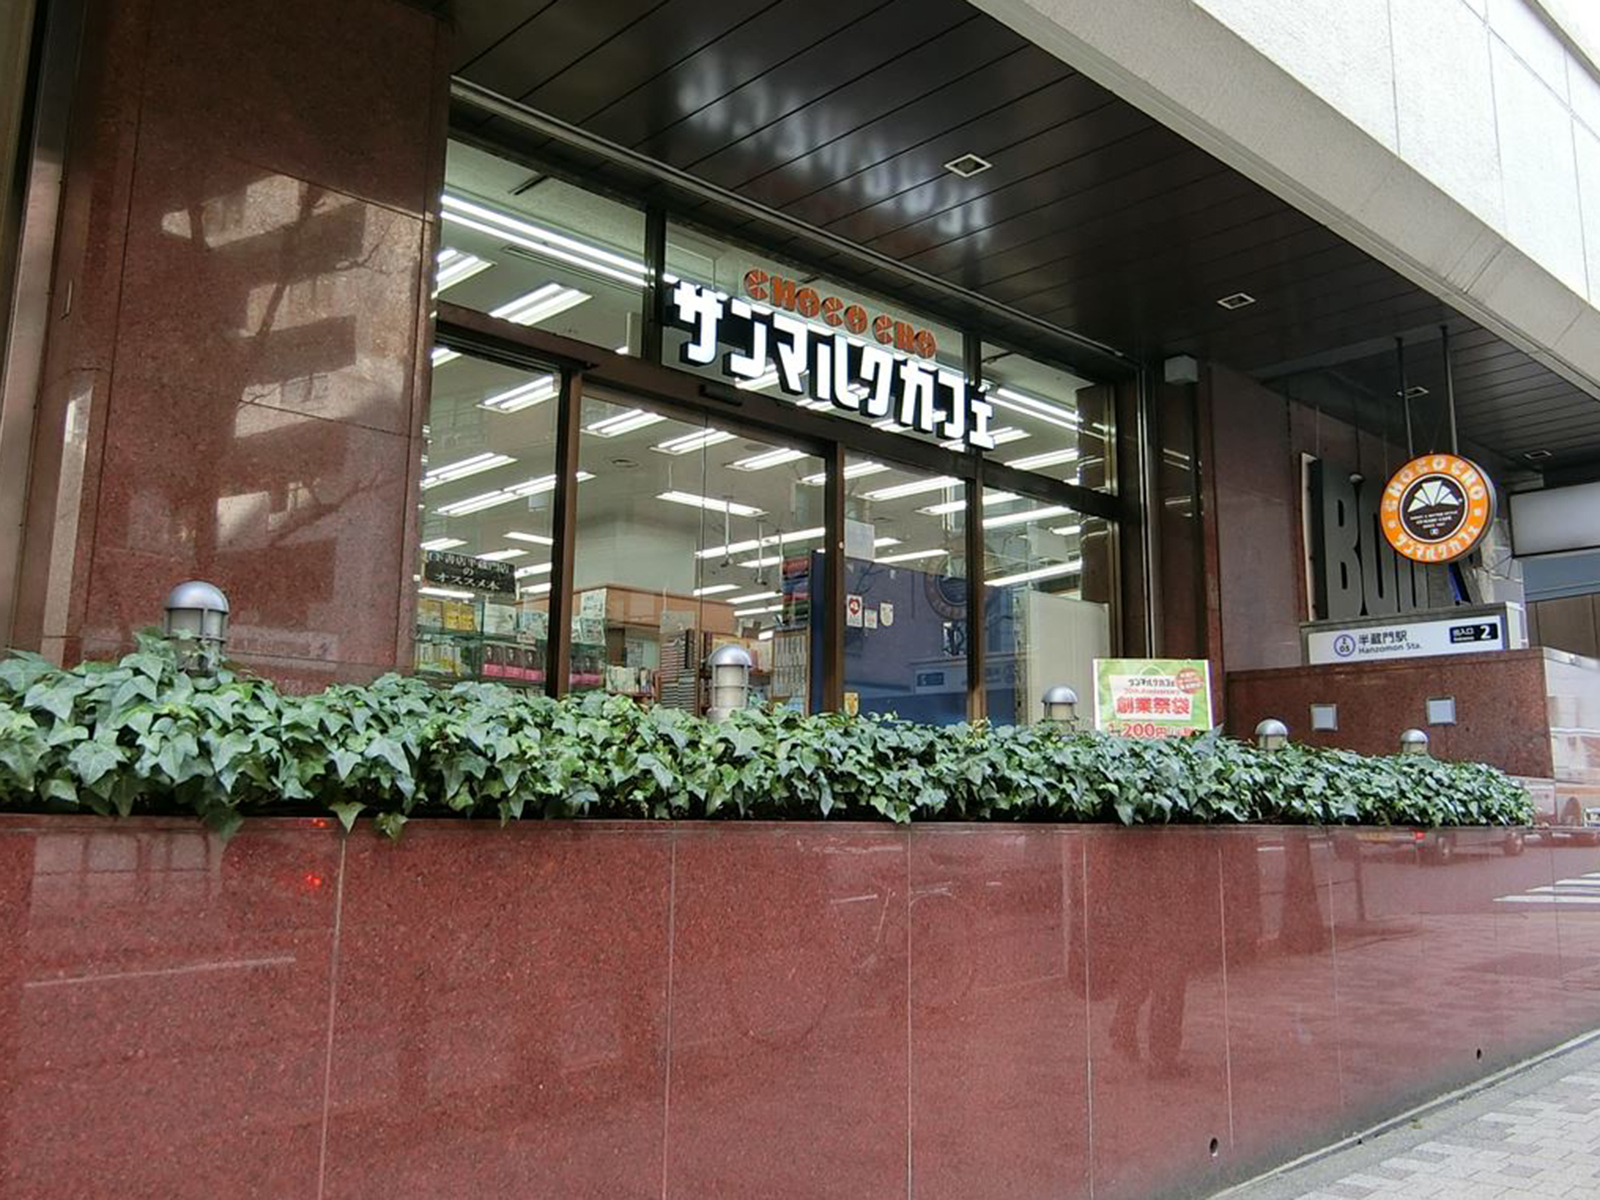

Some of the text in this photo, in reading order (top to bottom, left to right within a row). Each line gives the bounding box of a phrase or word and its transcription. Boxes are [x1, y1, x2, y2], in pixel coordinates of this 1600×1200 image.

[744, 269, 868, 334] CHOCO
[670, 281, 996, 450] サンマルクカフェ
[462, 566, 475, 577] の
[434, 572, 501, 591] オススメ本
[1358, 630, 1408, 646] 半蔵門駅
[1479, 625, 1492, 640] 2
[1358, 644, 1404, 654] Hanzomon
